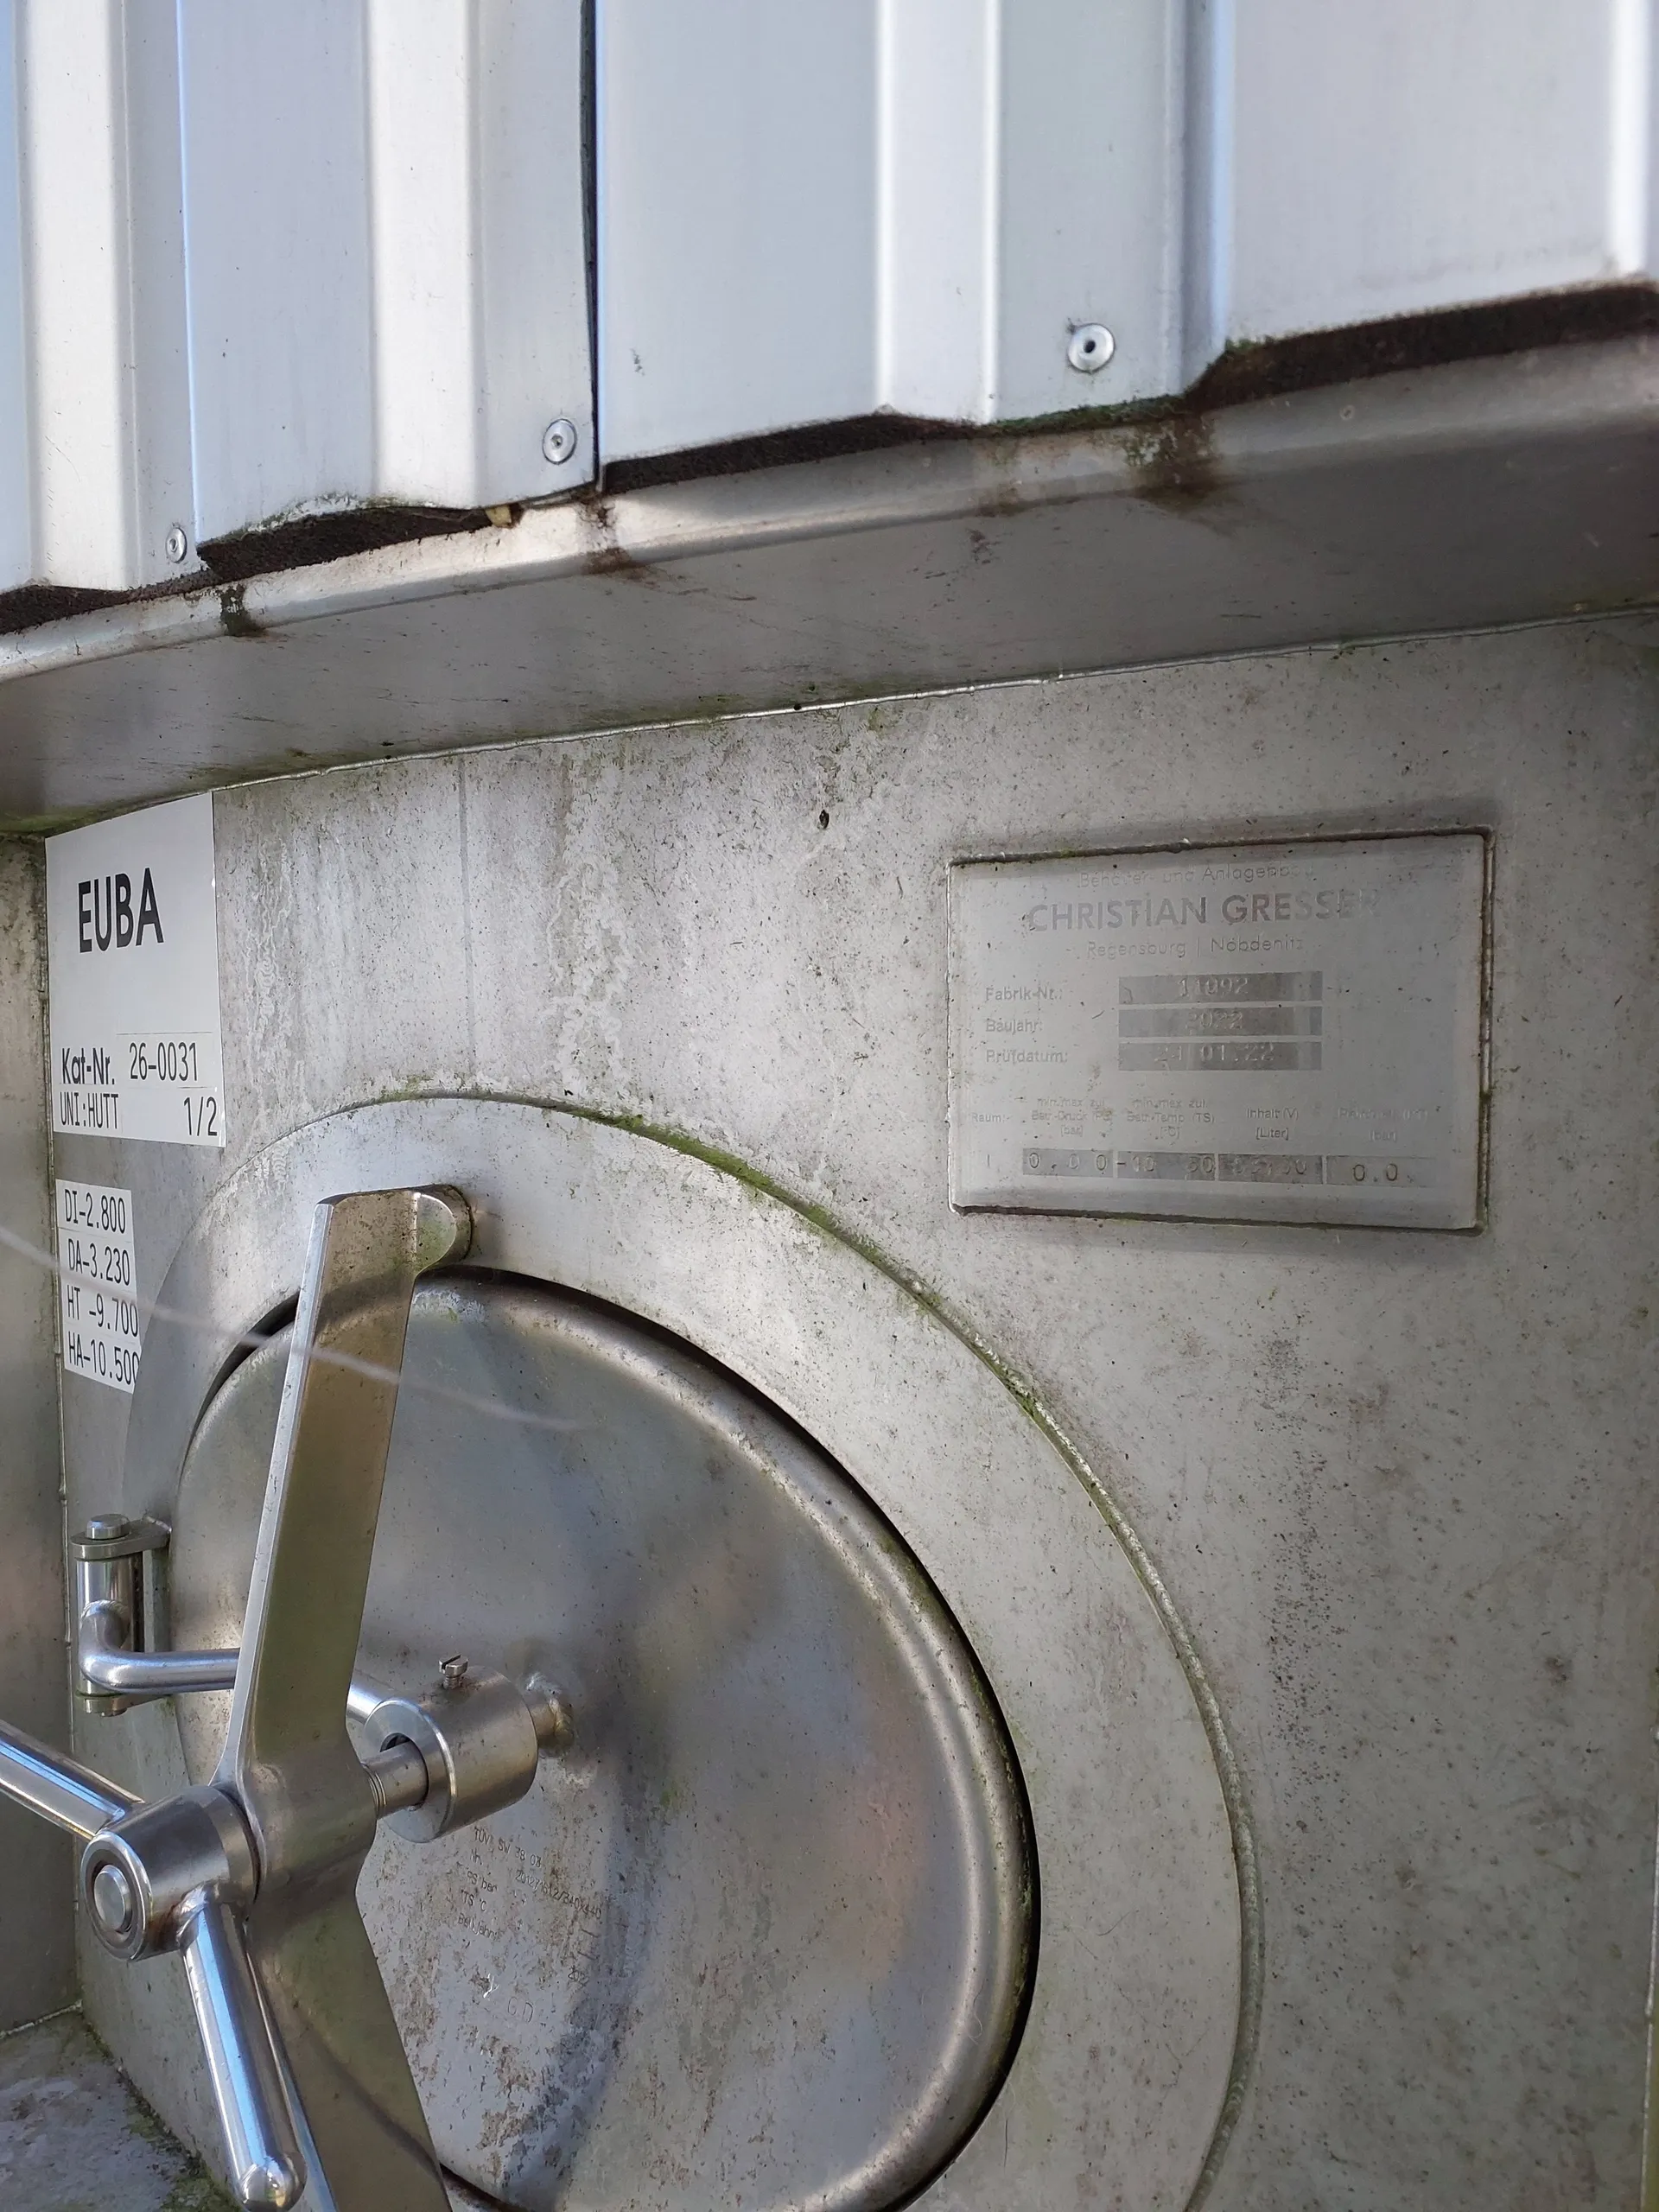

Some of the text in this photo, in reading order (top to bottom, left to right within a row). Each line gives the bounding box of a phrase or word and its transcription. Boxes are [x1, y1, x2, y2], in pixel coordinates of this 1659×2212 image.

[78, 867, 164, 953] EUBA
[1028, 888, 1382, 931] CHRISTIAN GRESSER
[1087, 939, 1186, 959] Regensburg
[985, 1019, 1043, 1035] Baujahr:
[61, 1042, 198, 1085] Kat-Nr. 26-0031
[184, 1096, 218, 1136] 1/2
[1247, 1107, 1281, 1119] Inhalt
[1255, 1128, 1289, 1141] [Liter]
[64, 1188, 126, 1235] DI-2.800
[67, 1237, 130, 1287] DA-3.230
[67, 1284, 80, 1321] HT
